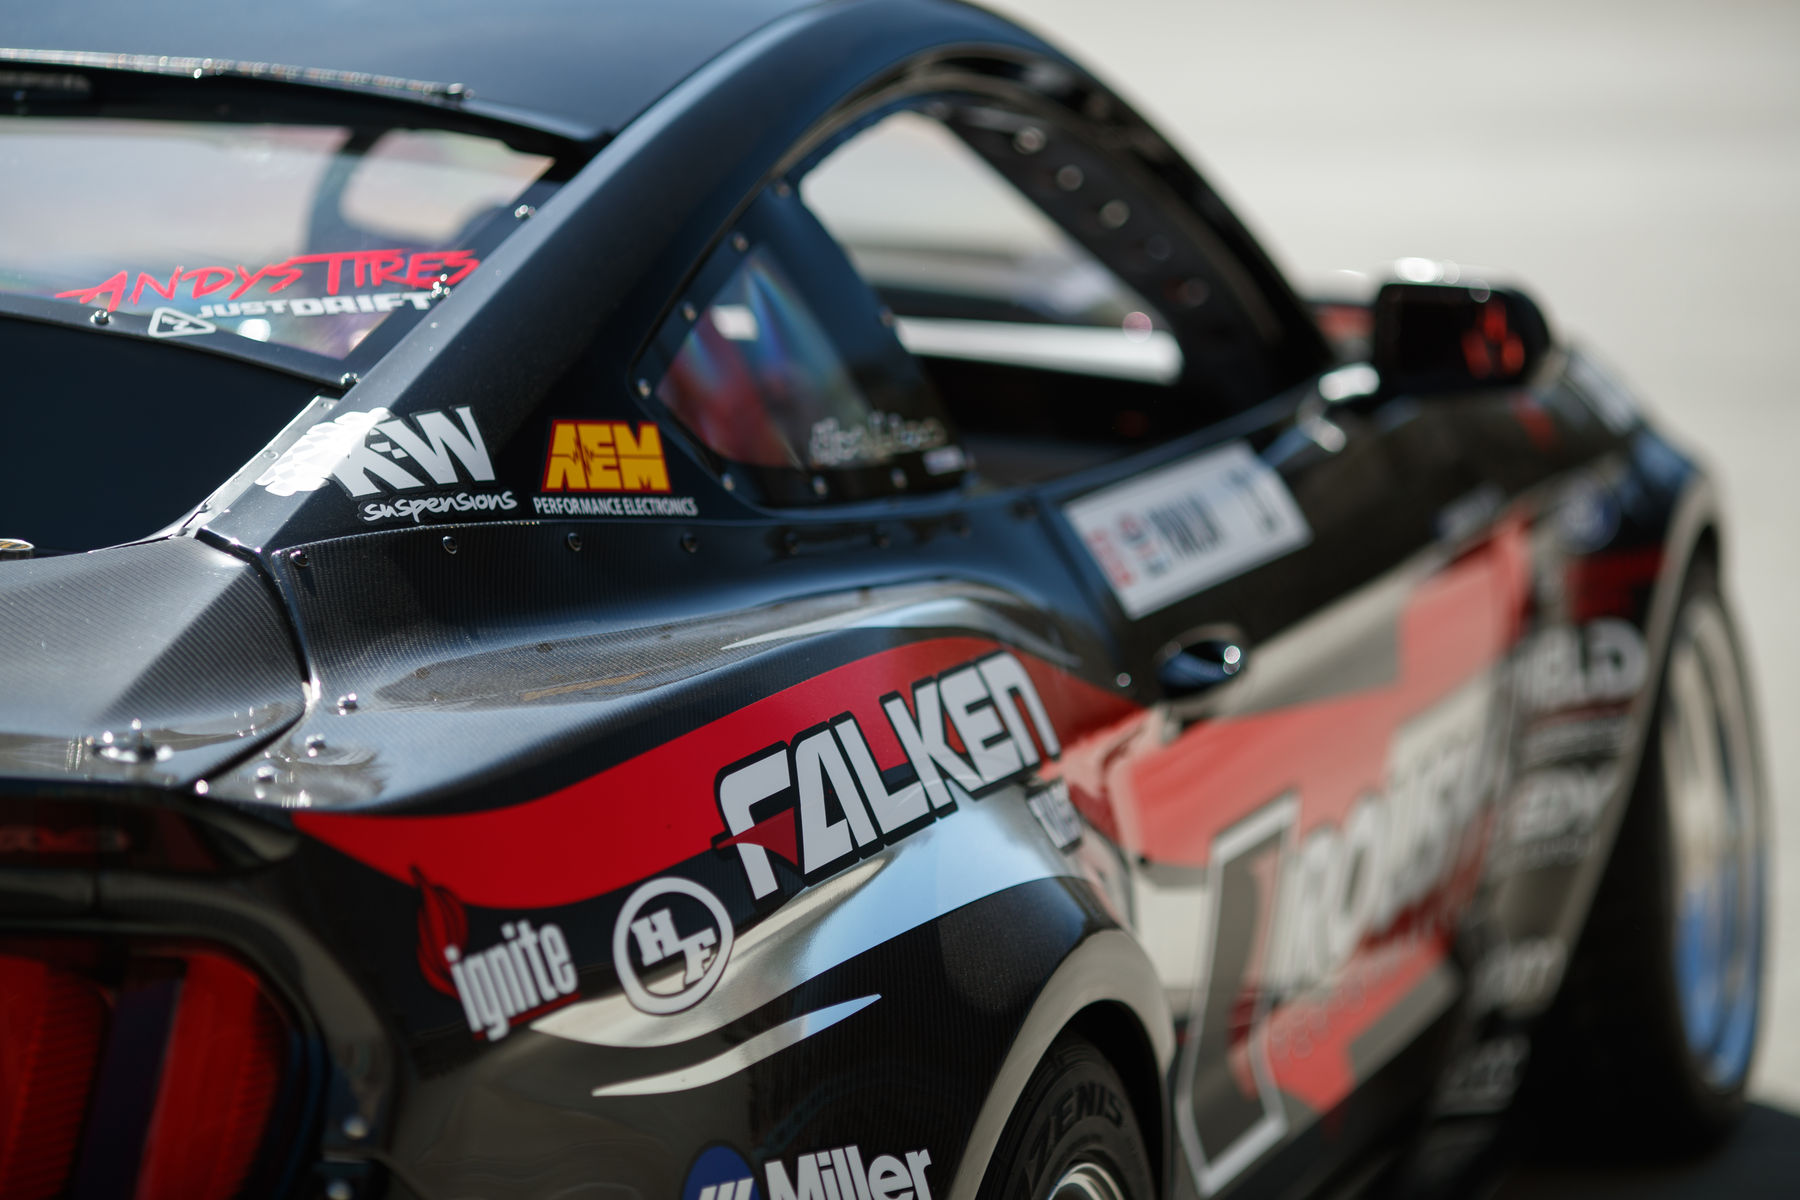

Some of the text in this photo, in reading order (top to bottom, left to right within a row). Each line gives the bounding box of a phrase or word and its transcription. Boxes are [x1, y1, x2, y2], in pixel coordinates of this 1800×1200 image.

[55, 248, 481, 312] ANDYS TIRES
[332, 405, 496, 498] KW
[541, 419, 672, 493] AEM
[363, 490, 518, 524] suspensions
[533, 496, 699, 517] PERFORMANCE ELECTRONICS
[717, 651, 1061, 901] FALKEN
[445, 919, 579, 1042] ignite
[764, 1145, 932, 1200] Miller
